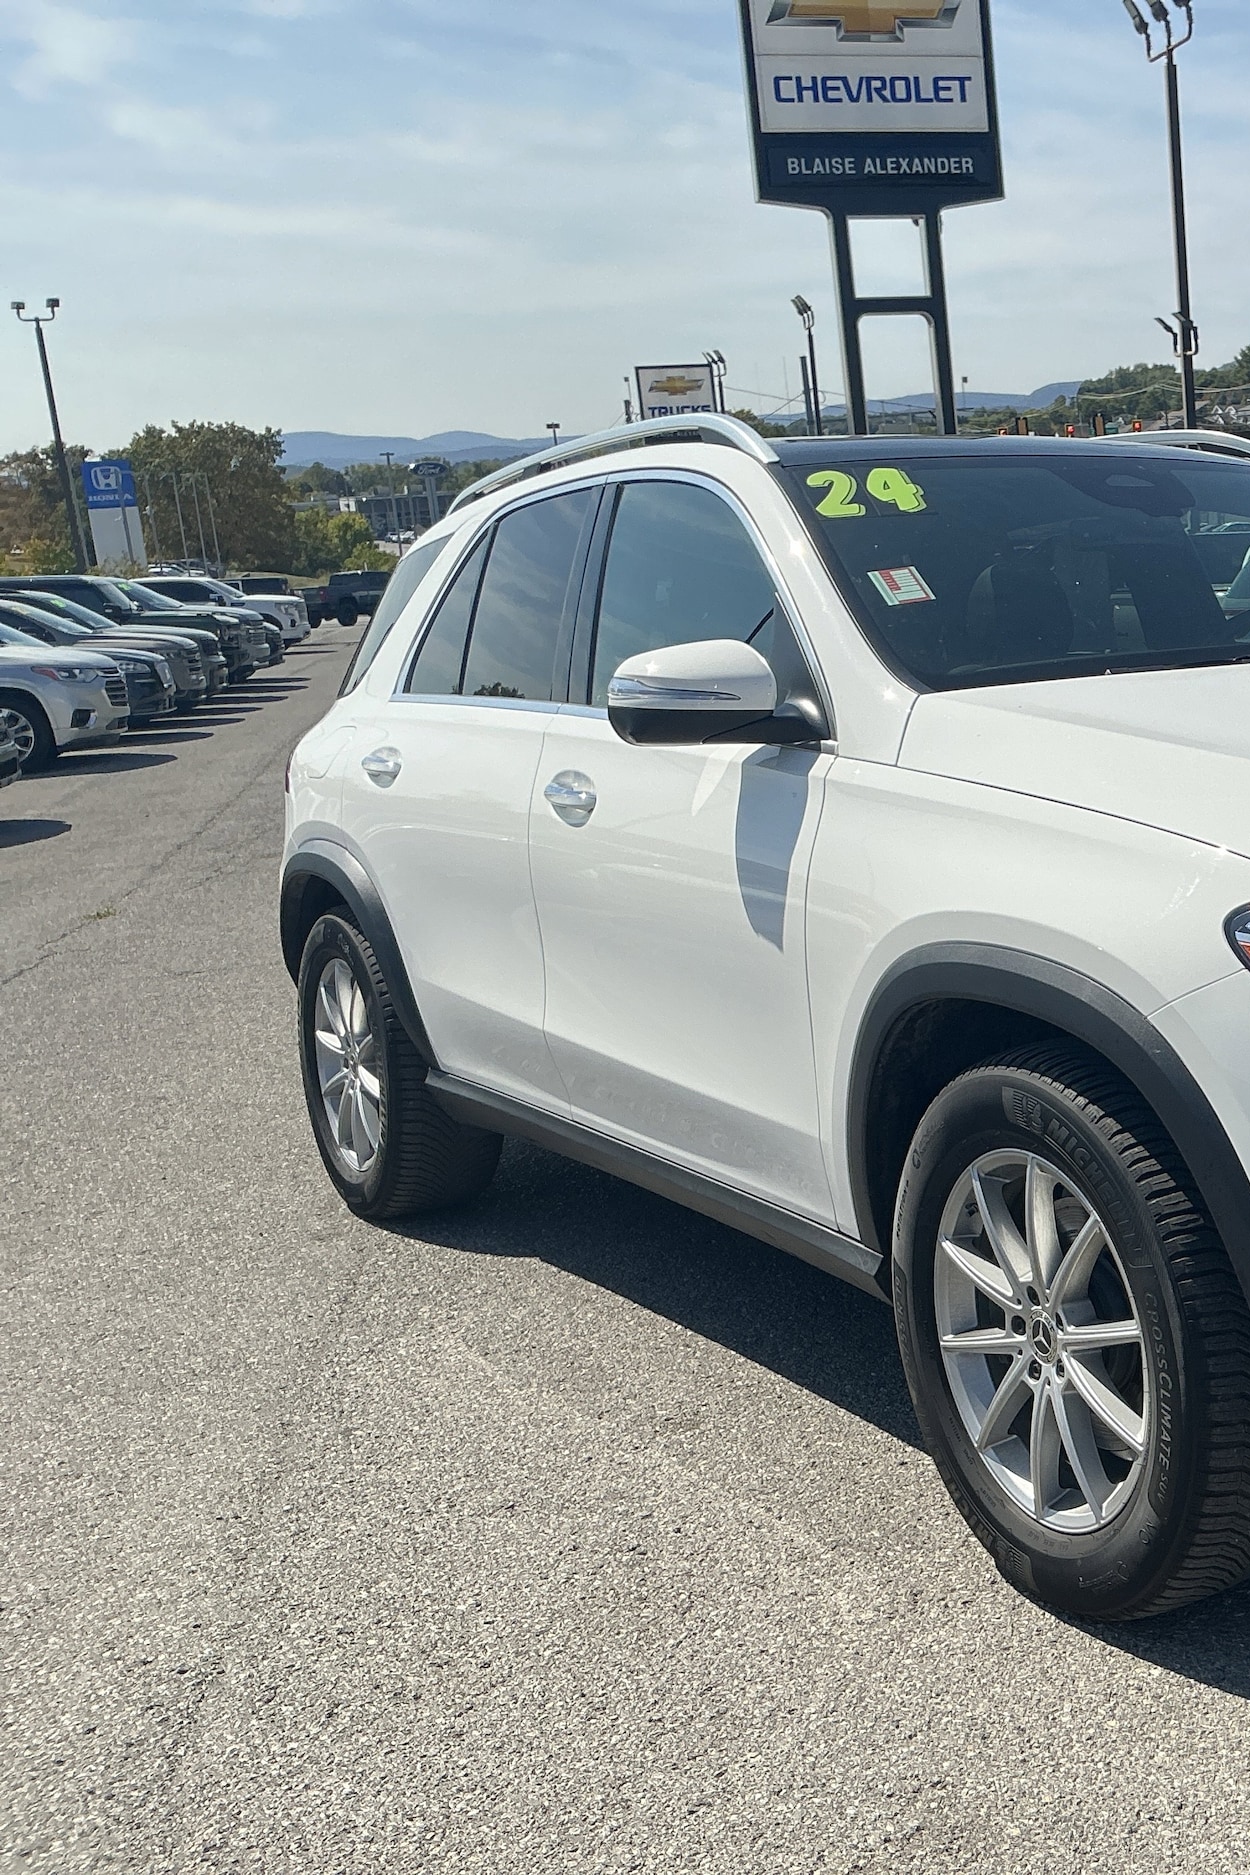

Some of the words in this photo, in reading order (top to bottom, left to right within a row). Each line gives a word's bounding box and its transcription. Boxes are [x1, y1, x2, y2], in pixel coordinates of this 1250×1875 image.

[773, 75, 972, 104] CHEVROLET
[787, 157, 856, 175] BLAISE
[864, 157, 974, 175] ALEXANDER
[806, 467, 928, 519] 24
